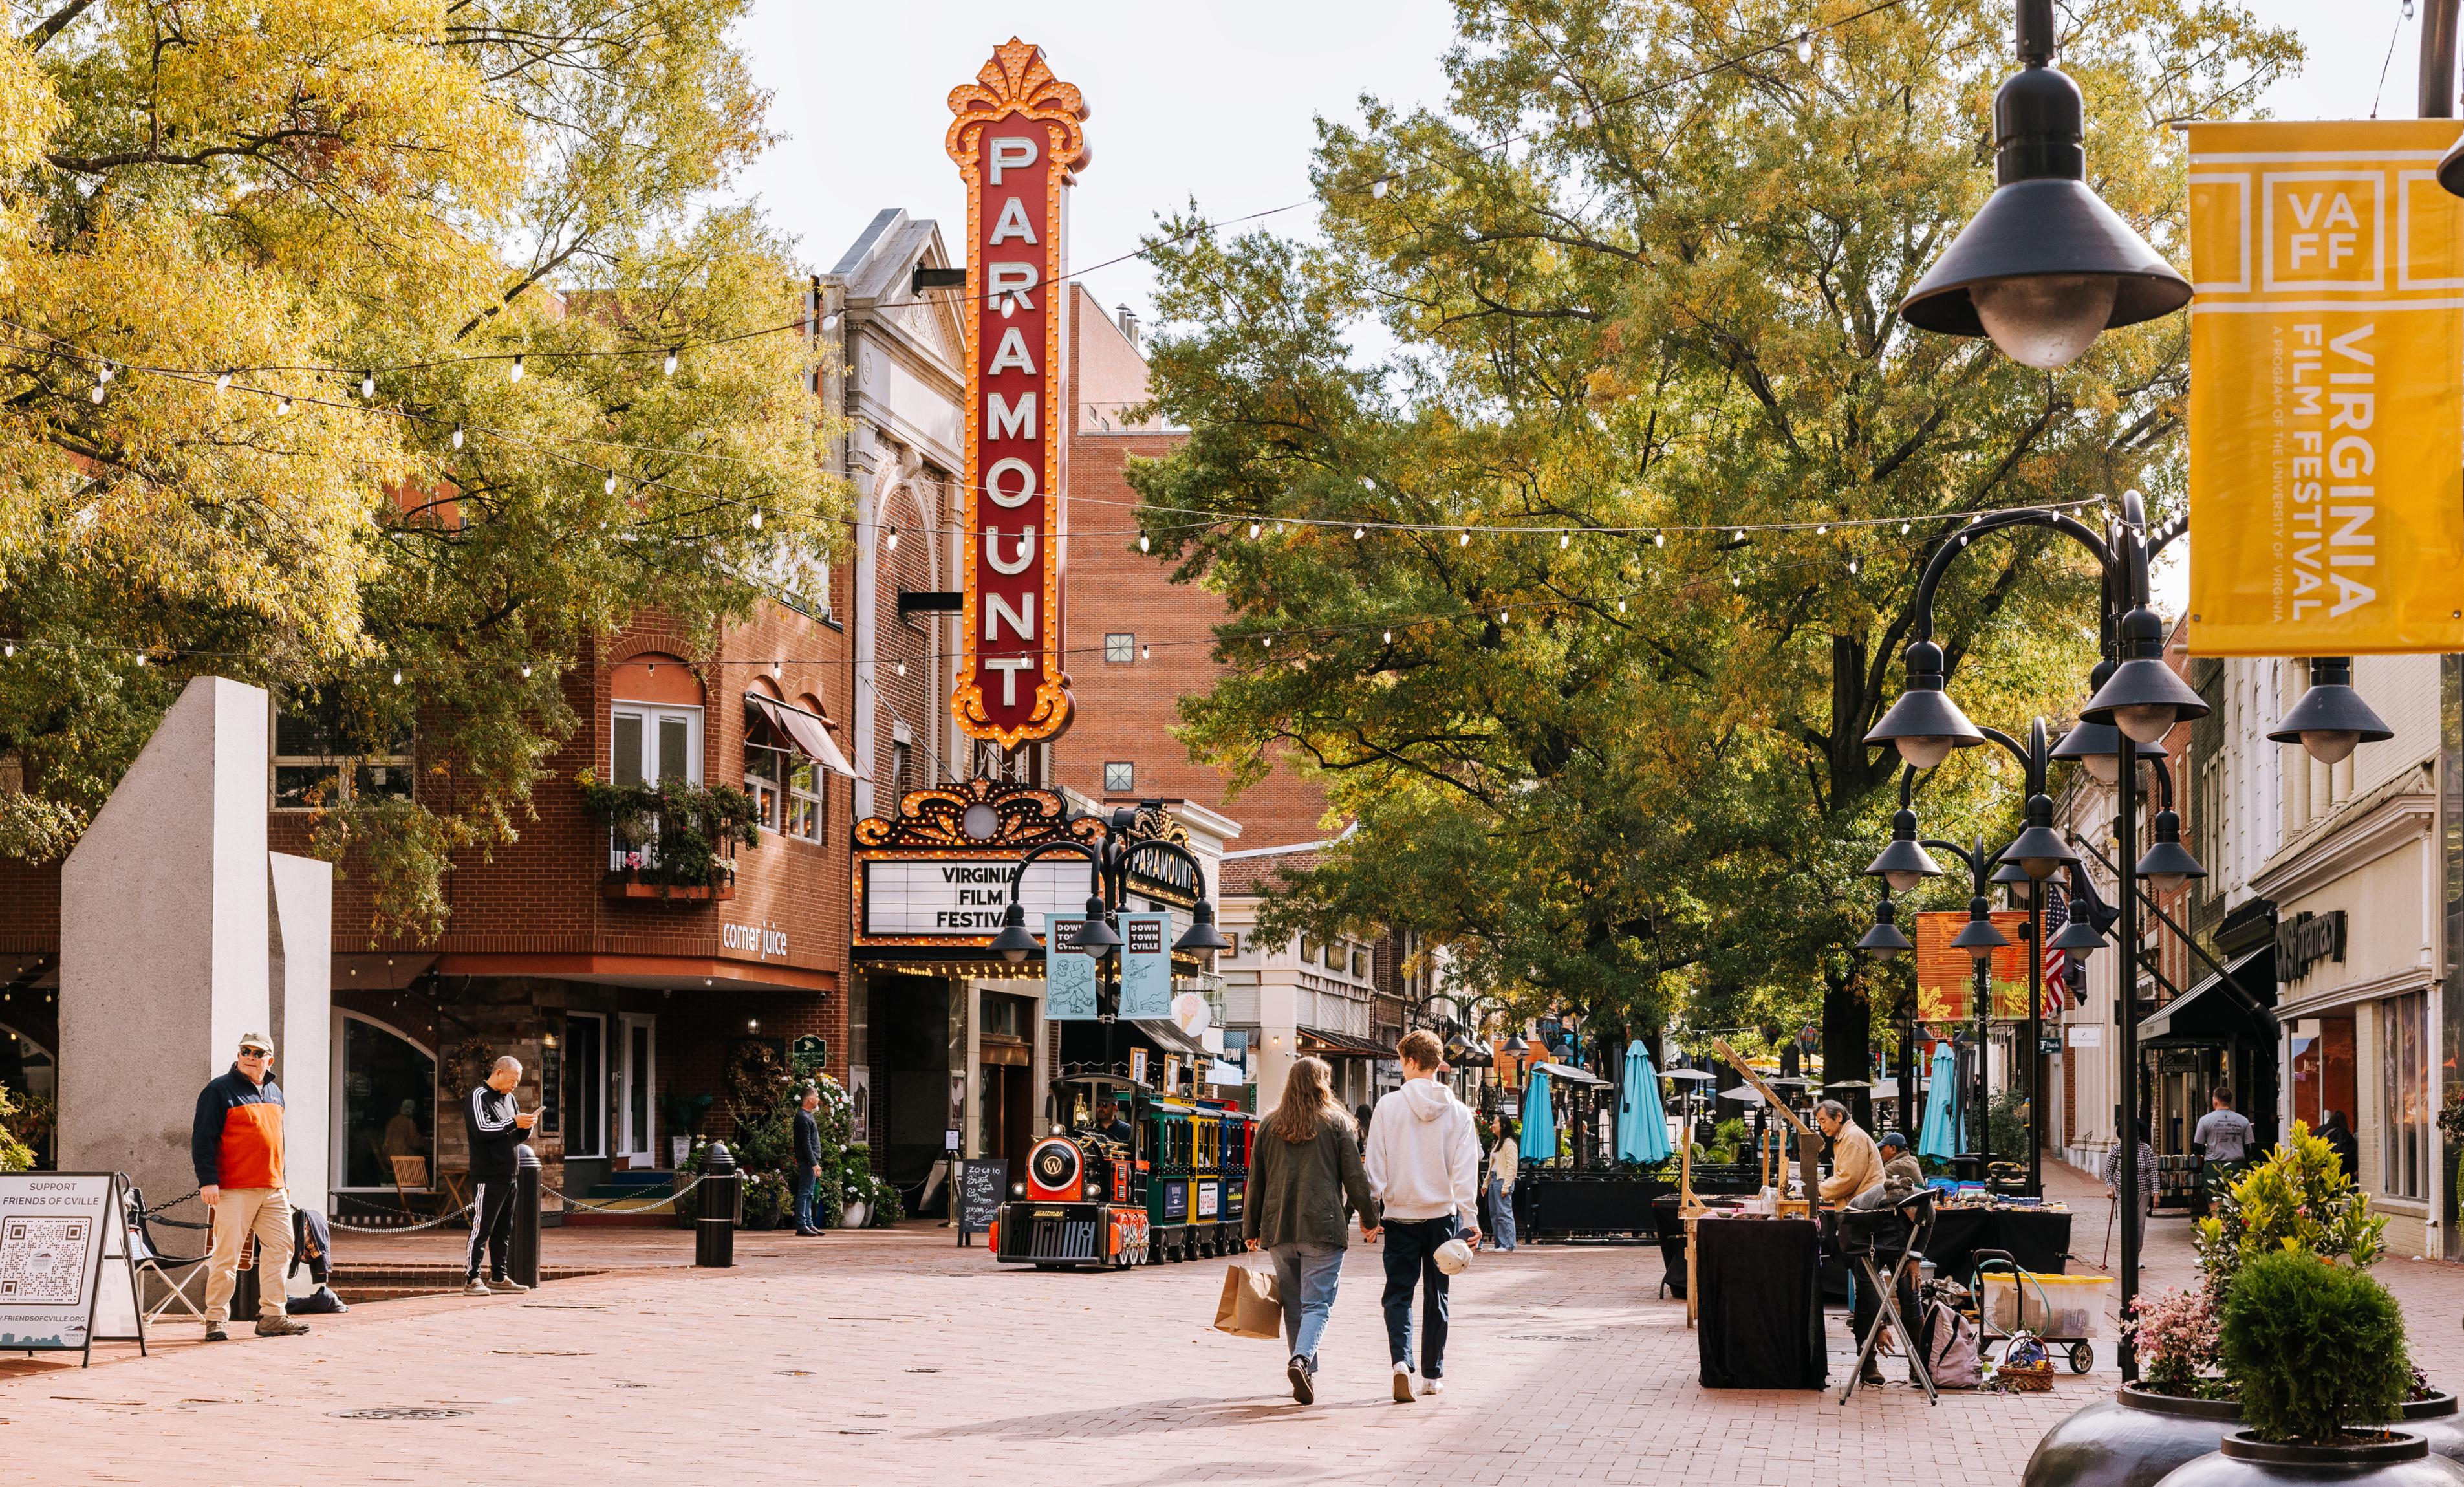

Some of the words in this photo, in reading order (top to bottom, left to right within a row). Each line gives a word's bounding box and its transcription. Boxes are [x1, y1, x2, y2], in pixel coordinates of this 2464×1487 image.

[2287, 192, 2359, 229] VA
[2291, 233, 2357, 269] FF
[2273, 326, 2282, 335] A
[2273, 340, 2284, 405] PROGRAM
[2293, 324, 2322, 415] FILM
[985, 136, 1039, 706] PARAMOUNT
[2272, 409, 2284, 427] OF
[2273, 432, 2284, 456] THE
[2329, 322, 2376, 618] VIRGINIA
[2273, 461, 2284, 537] UNIVERSITY
[2293, 431, 2322, 622] FESTIVAL
[2273, 543, 2284, 560] OF
[2273, 565, 2283, 624] VIRGINIA
[942, 867, 1017, 883] VIRGINIA
[1132, 847, 1193, 889] PARAMOUNT
[960, 890, 1003, 905] FILM
[723, 922, 761, 952] corner
[761, 920, 787, 961] juice
[1223, 1048, 1240, 1061] VPM
[3, 1197, 46, 1205] FRIENDS
[48, 1197, 62, 1205] OF
[64, 1197, 100, 1205] CVILLE
